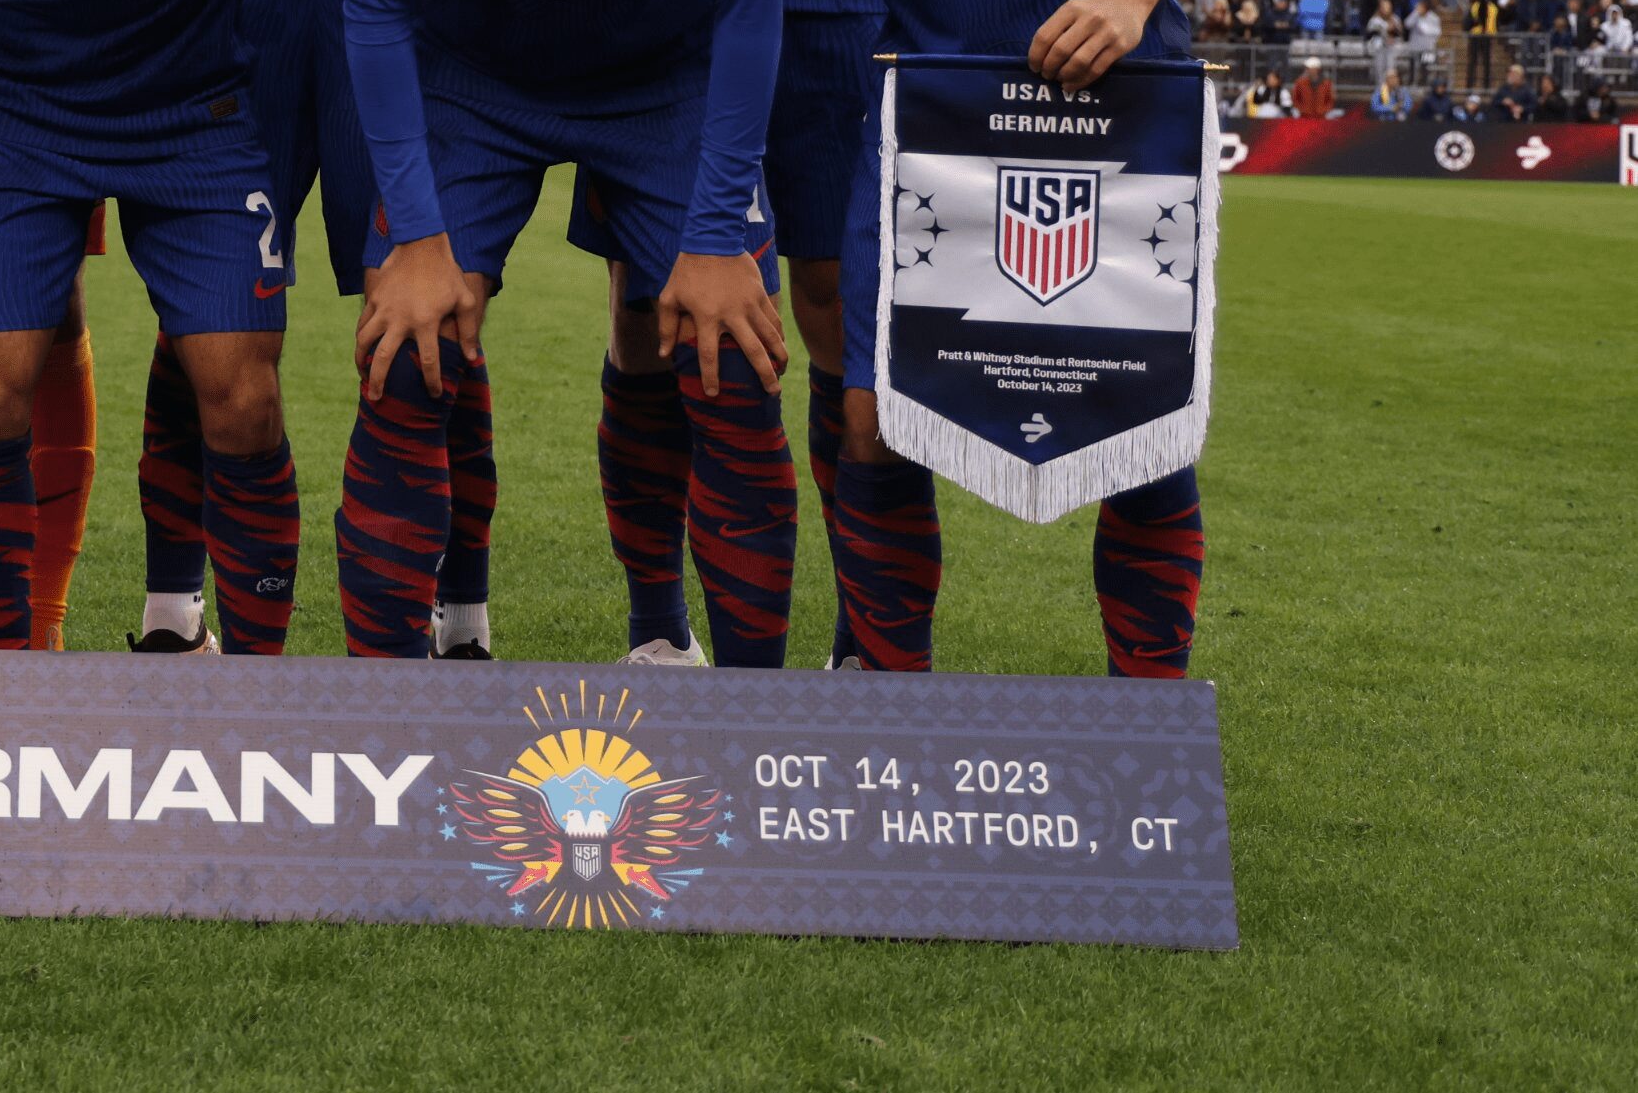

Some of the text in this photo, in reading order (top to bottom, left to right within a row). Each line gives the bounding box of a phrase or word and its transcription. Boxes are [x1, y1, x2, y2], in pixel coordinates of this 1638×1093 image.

[1002, 83, 1052, 102] USA
[989, 113, 1112, 135] GERMANY
[1006, 176, 1091, 227] USA
[245, 191, 284, 269] 2
[937, 349, 1147, 372] Pratt & Whitney Stadium at Rentschler Field
[983, 364, 1098, 381] Hartford, Connecticut
[997, 379, 1083, 394] October 14, 2023
[754, 753, 1050, 797] OCT 14, 2023
[759, 806, 1179, 855] EAST HARTFORD, CT
[575, 845, 599, 860] USA
